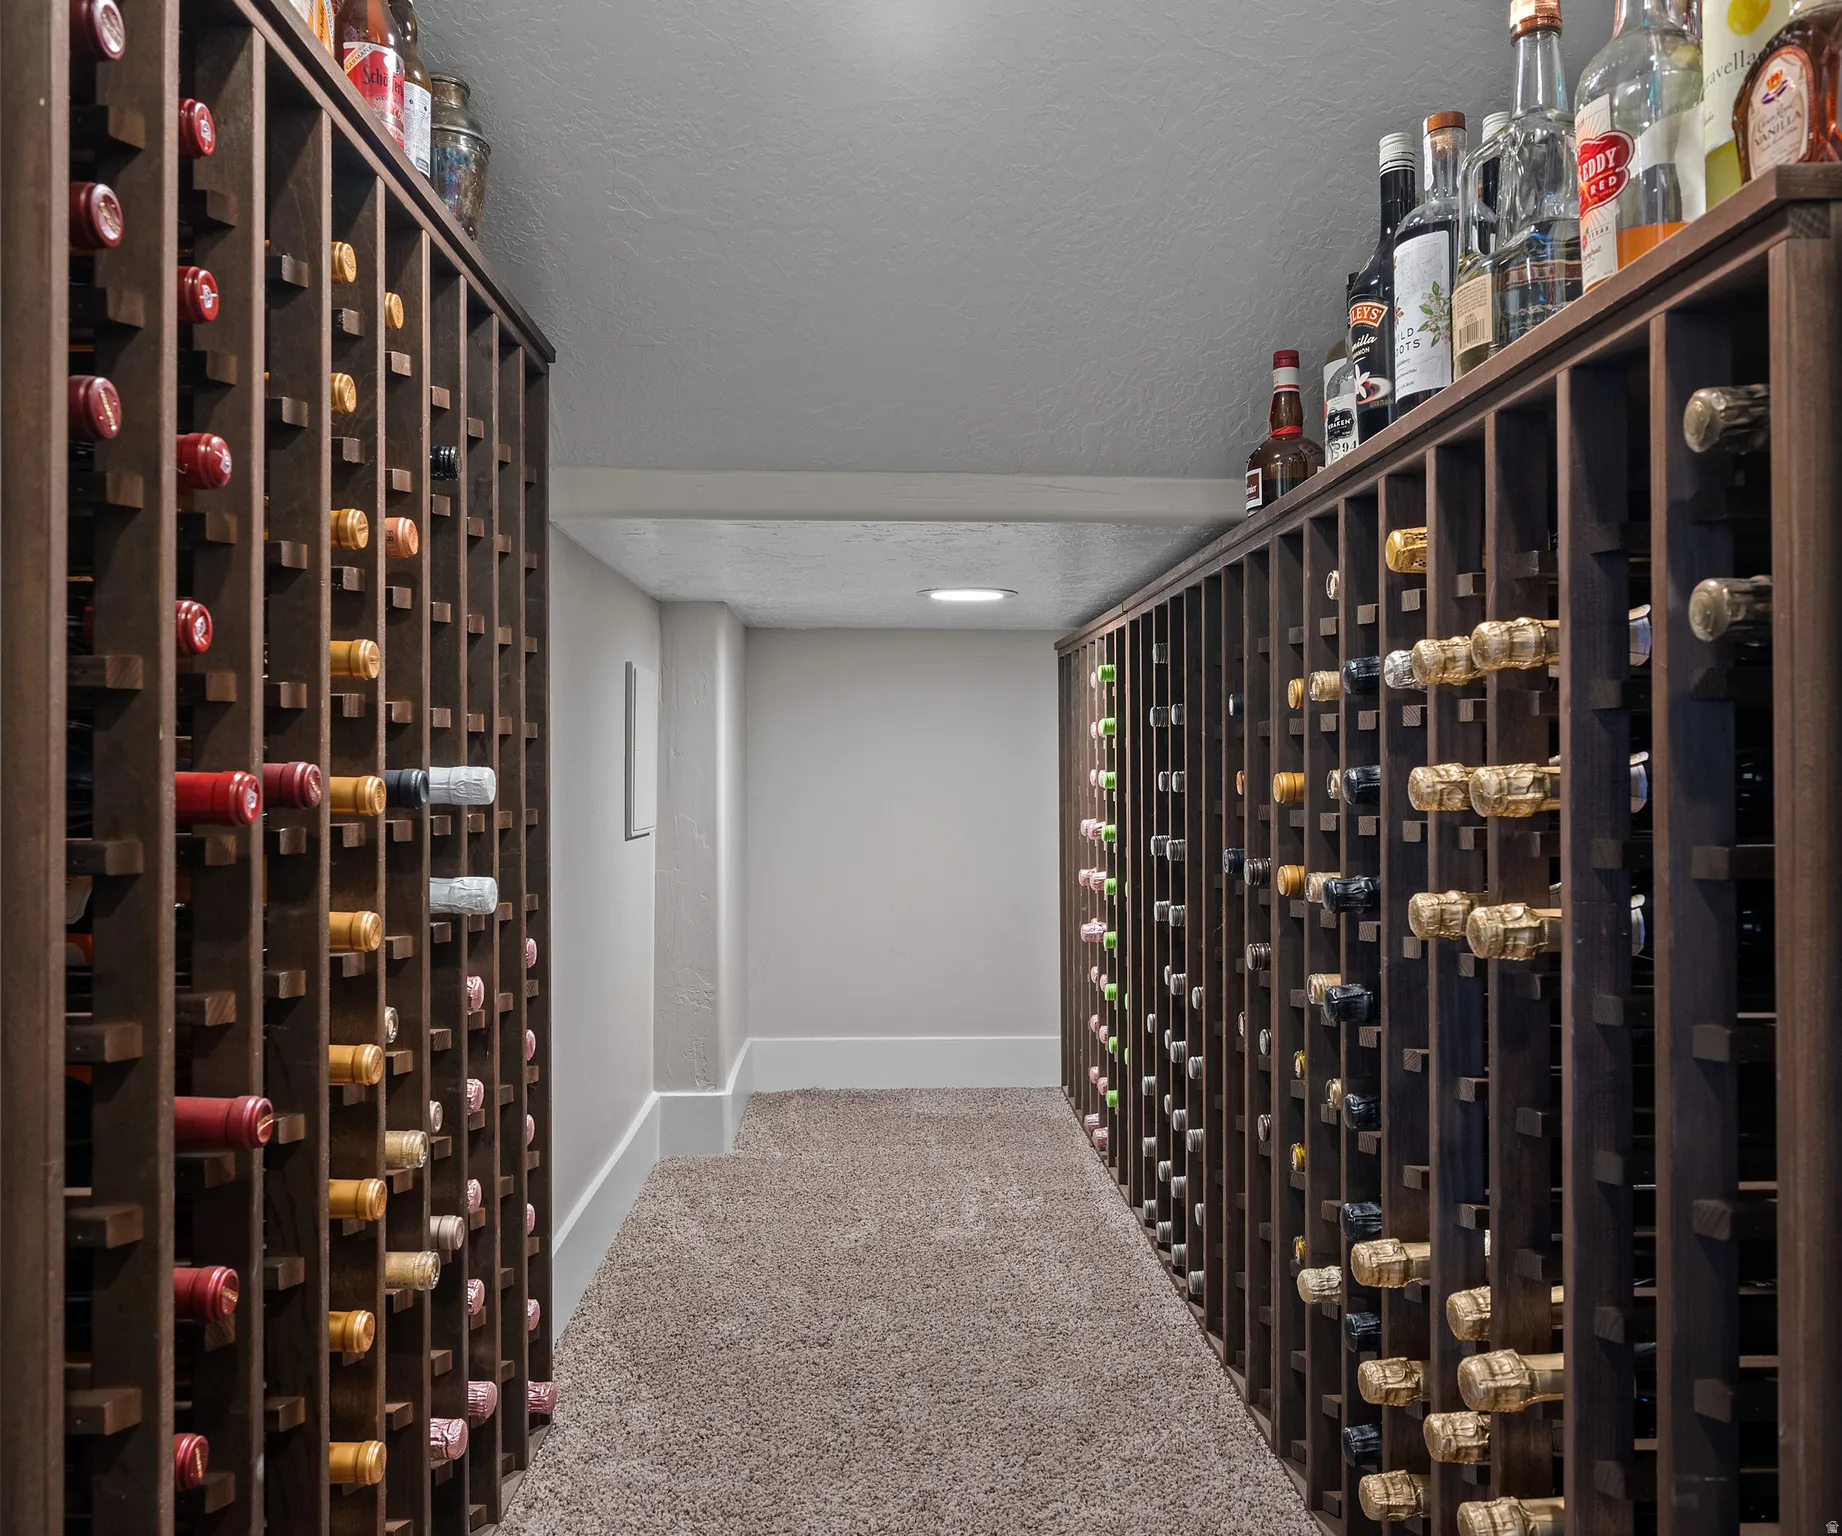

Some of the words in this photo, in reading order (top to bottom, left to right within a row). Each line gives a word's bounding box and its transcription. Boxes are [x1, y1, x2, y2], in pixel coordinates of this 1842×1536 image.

[345, 44, 372, 70] GERMANY
[1582, 147, 1617, 182] EDDY
[1590, 176, 1617, 196] RED
